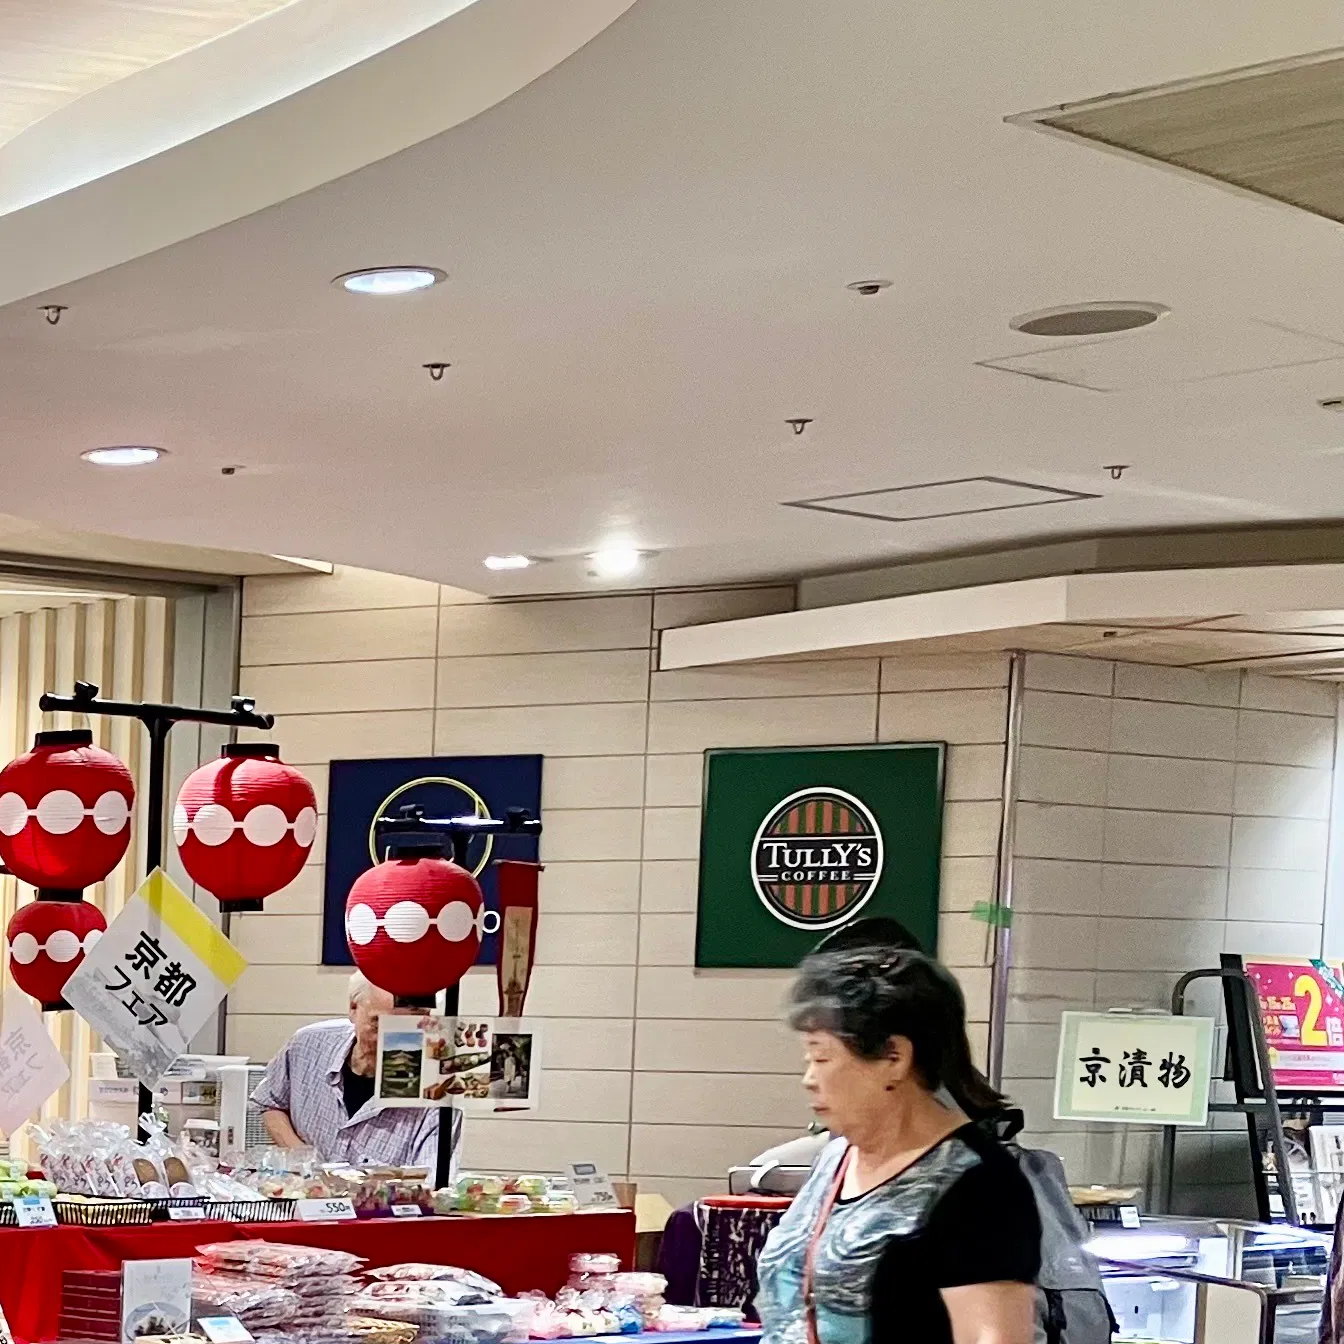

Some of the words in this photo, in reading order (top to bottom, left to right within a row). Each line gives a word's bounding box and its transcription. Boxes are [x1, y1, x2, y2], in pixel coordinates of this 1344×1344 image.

[762, 843, 872, 868] TULLY'S
[781, 870, 851, 881] COFFEE
[124, 930, 197, 1007] 京都
[105, 965, 169, 1026] フェア
[1079, 1047, 1191, 1089] 京漬物
